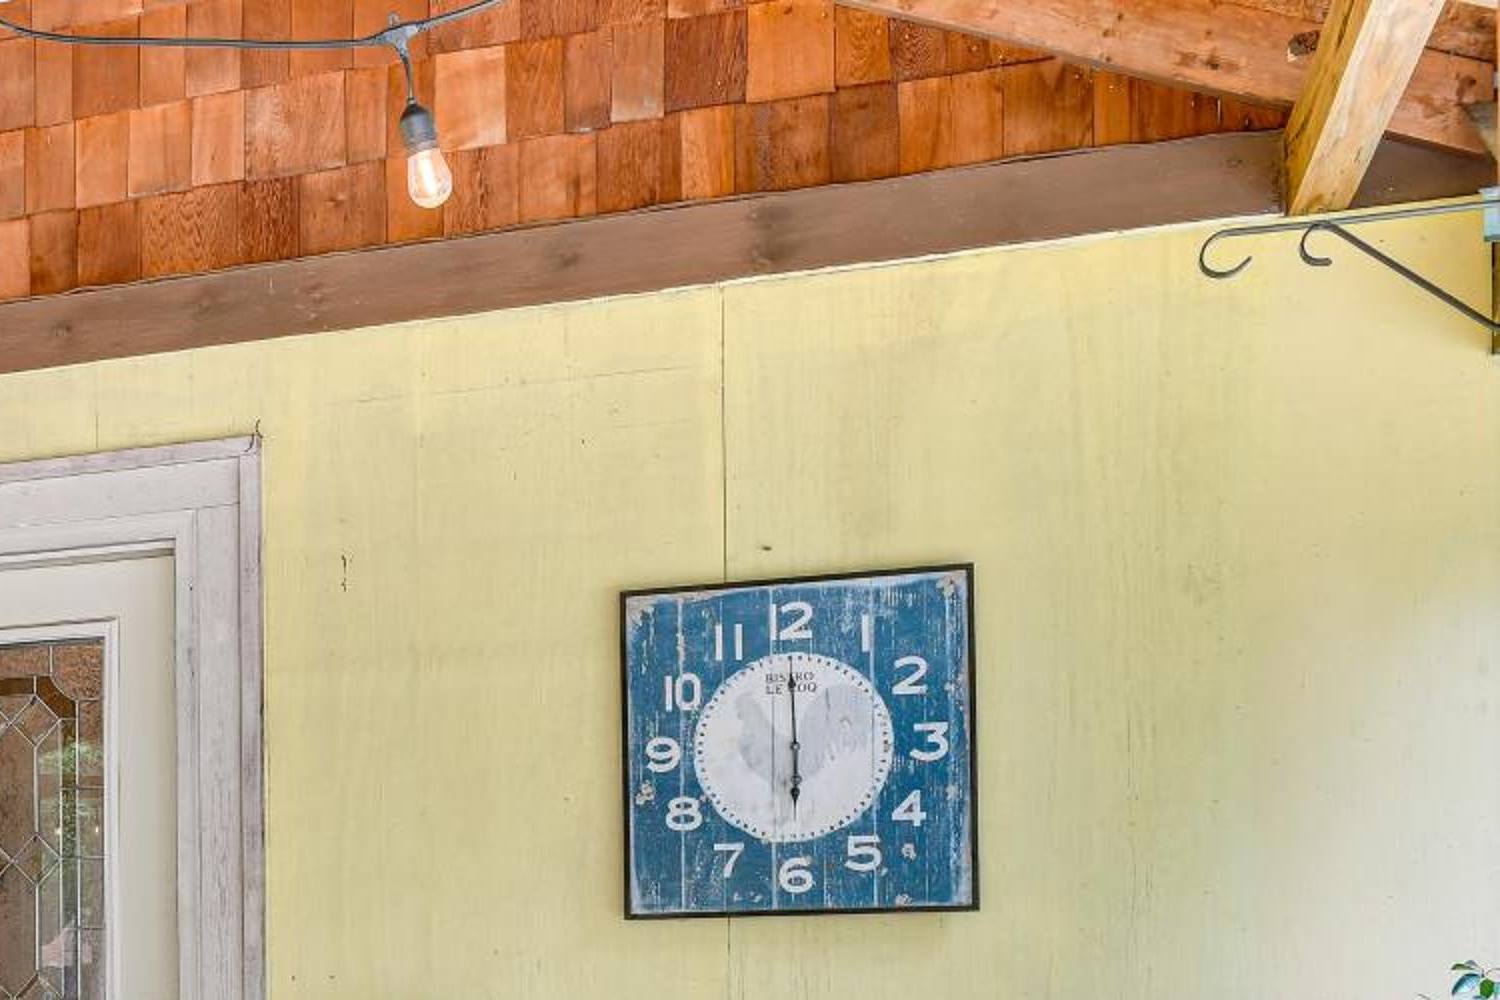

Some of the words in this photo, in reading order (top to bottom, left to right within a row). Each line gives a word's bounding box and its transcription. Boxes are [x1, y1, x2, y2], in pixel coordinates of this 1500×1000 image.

[771, 601, 813, 641] 12
[862, 613, 870, 652] 1
[715, 623, 743, 661] 11
[665, 674, 702, 712] 10
[892, 656, 928, 695] 2
[645, 736, 681, 773] 9
[910, 721, 949, 762] 3
[666, 797, 702, 831] 8
[891, 789, 927, 827] 4
[713, 842, 745, 879] 7
[844, 835, 883, 872] 5
[779, 858, 814, 893] 6
